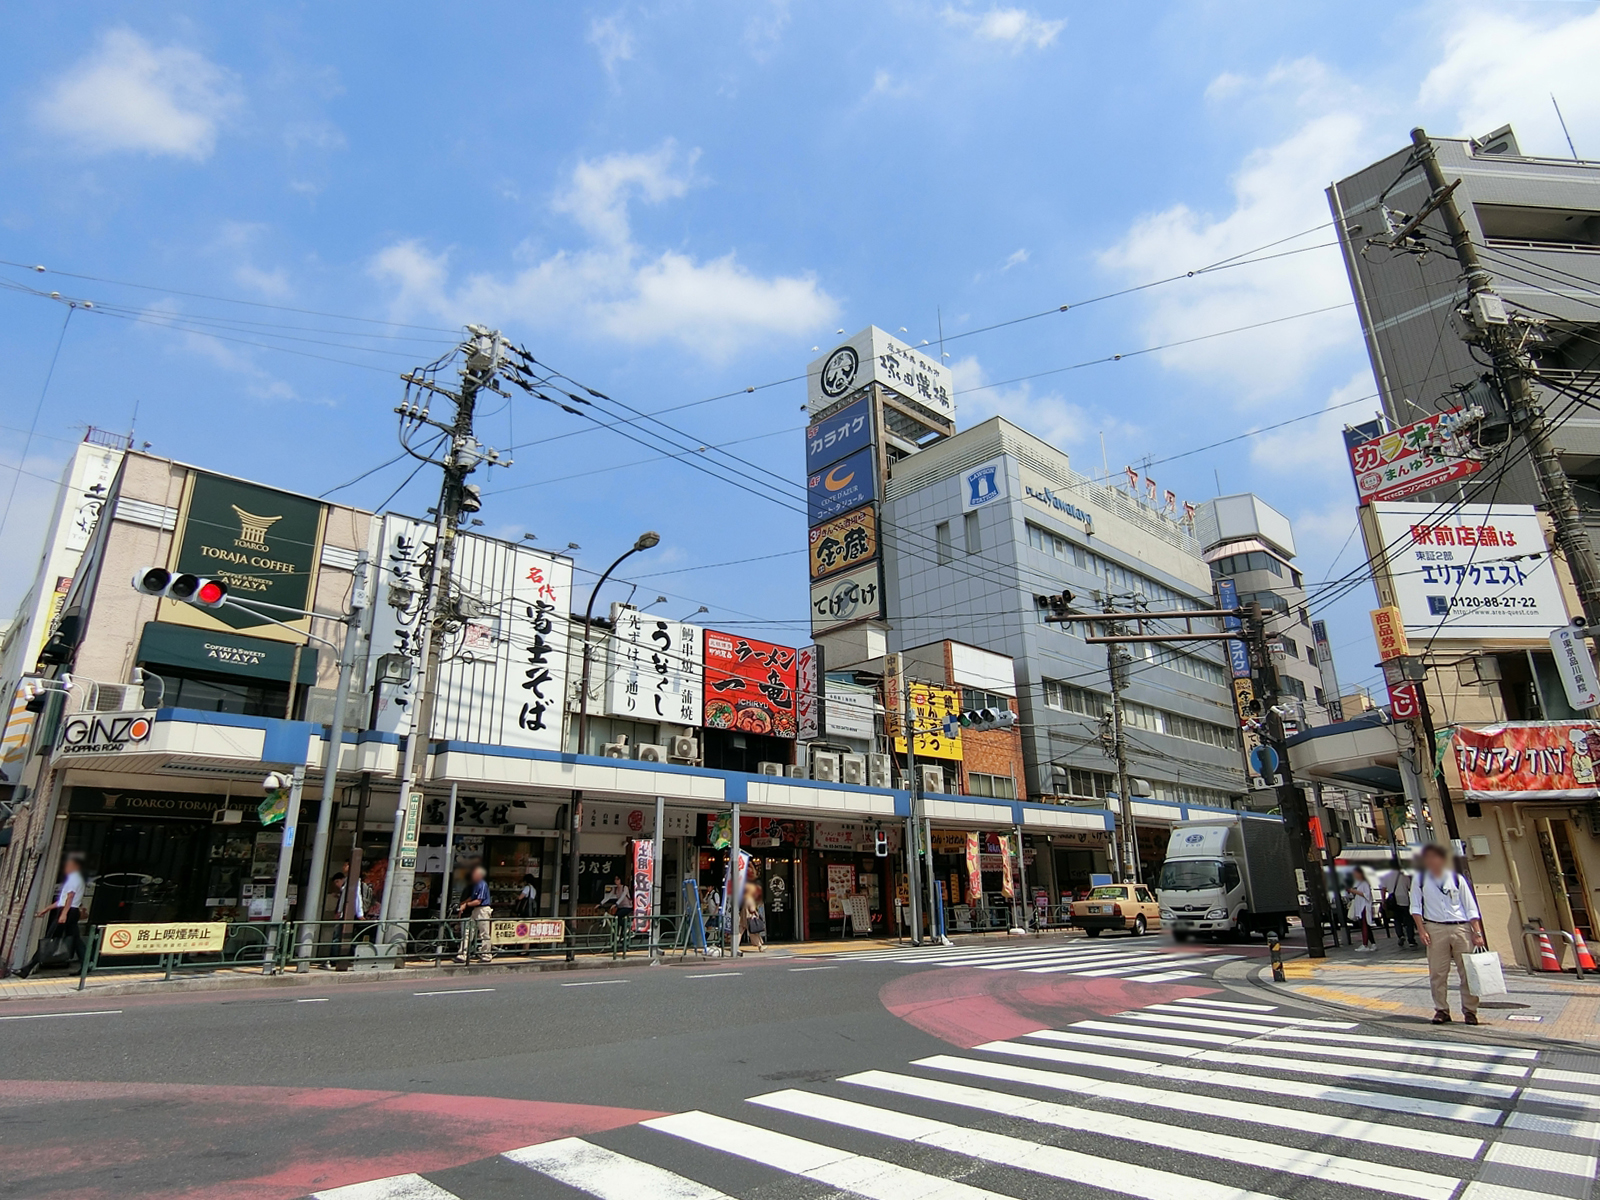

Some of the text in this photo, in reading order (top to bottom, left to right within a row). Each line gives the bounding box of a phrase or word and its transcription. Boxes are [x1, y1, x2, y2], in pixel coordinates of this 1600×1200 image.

[880, 354, 950, 409] 塚田農場
[808, 425, 820, 439] 5F
[810, 415, 865, 456] カラオケ
[809, 476, 821, 488] 4F
[968, 466, 996, 482] LAWSON
[233, 538, 270, 553] TOARCO
[1410, 525, 1518, 547] 駅前店舗は
[201, 545, 296, 574] TORAJA COFFEE
[221, 576, 267, 592] AWAYA
[525, 566, 557, 602] 名代
[1421, 564, 1528, 587] エリアクエスト
[813, 583, 877, 616] てけてけ
[1450, 596, 1538, 608] 0120-88-27-22
[1375, 611, 1396, 649] 商品券
[208, 650, 260, 666] AWAYA
[518, 599, 556, 732] 富士そば
[735, 640, 796, 672] ラーメン
[651, 621, 672, 717] うなくし
[710, 668, 793, 710] 一竜
[738, 698, 769, 709] ICHIRYU
[63, 743, 125, 754] SHOPPING ROAD
[125, 797, 175, 809] TOARCO
[178, 800, 218, 811] TORAJA
[137, 928, 211, 941] 路上喫煙禁止
